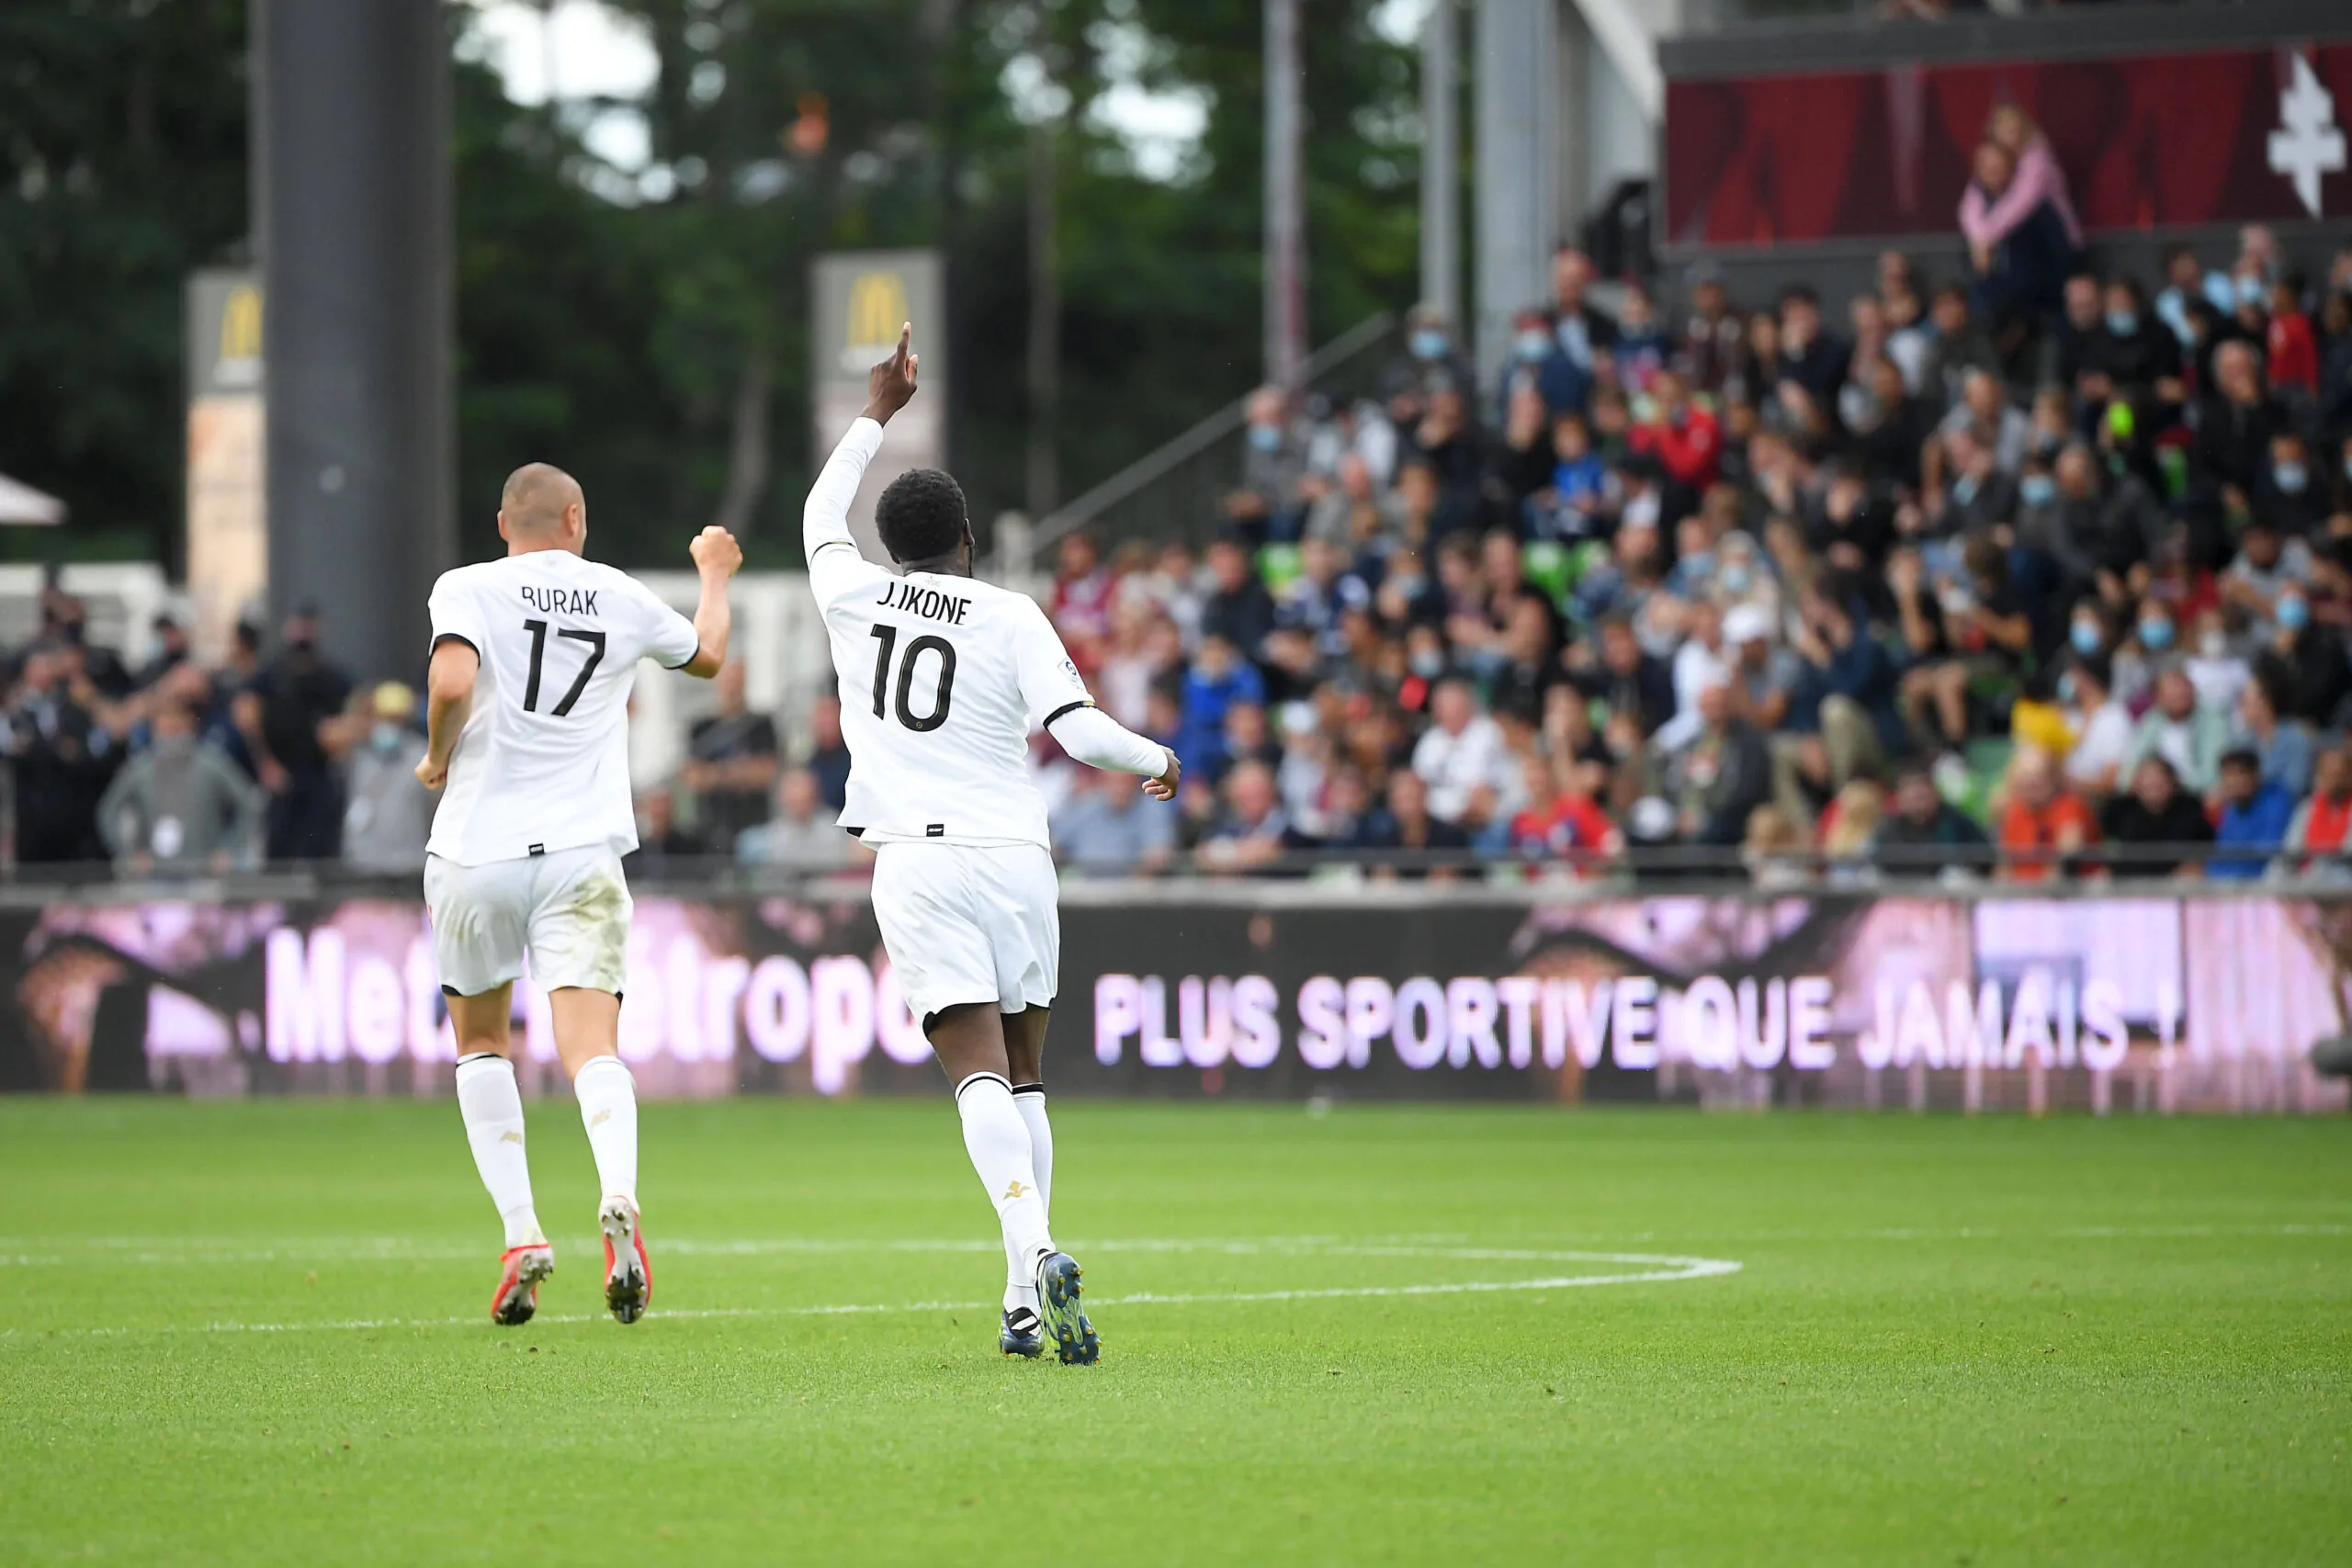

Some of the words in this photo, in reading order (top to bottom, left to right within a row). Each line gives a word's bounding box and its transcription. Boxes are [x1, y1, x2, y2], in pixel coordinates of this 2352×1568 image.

[521, 586, 599, 616] BURAK
[876, 581, 973, 625] J.IKONE
[523, 619, 606, 717] 17
[870, 623, 957, 733] 10
[1093, 974, 1282, 1069] PLUS
[1297, 975, 1658, 1070] SPORTIVE
[1684, 975, 1836, 1072] QUE
[1857, 977, 2129, 1070] JAMAIS
